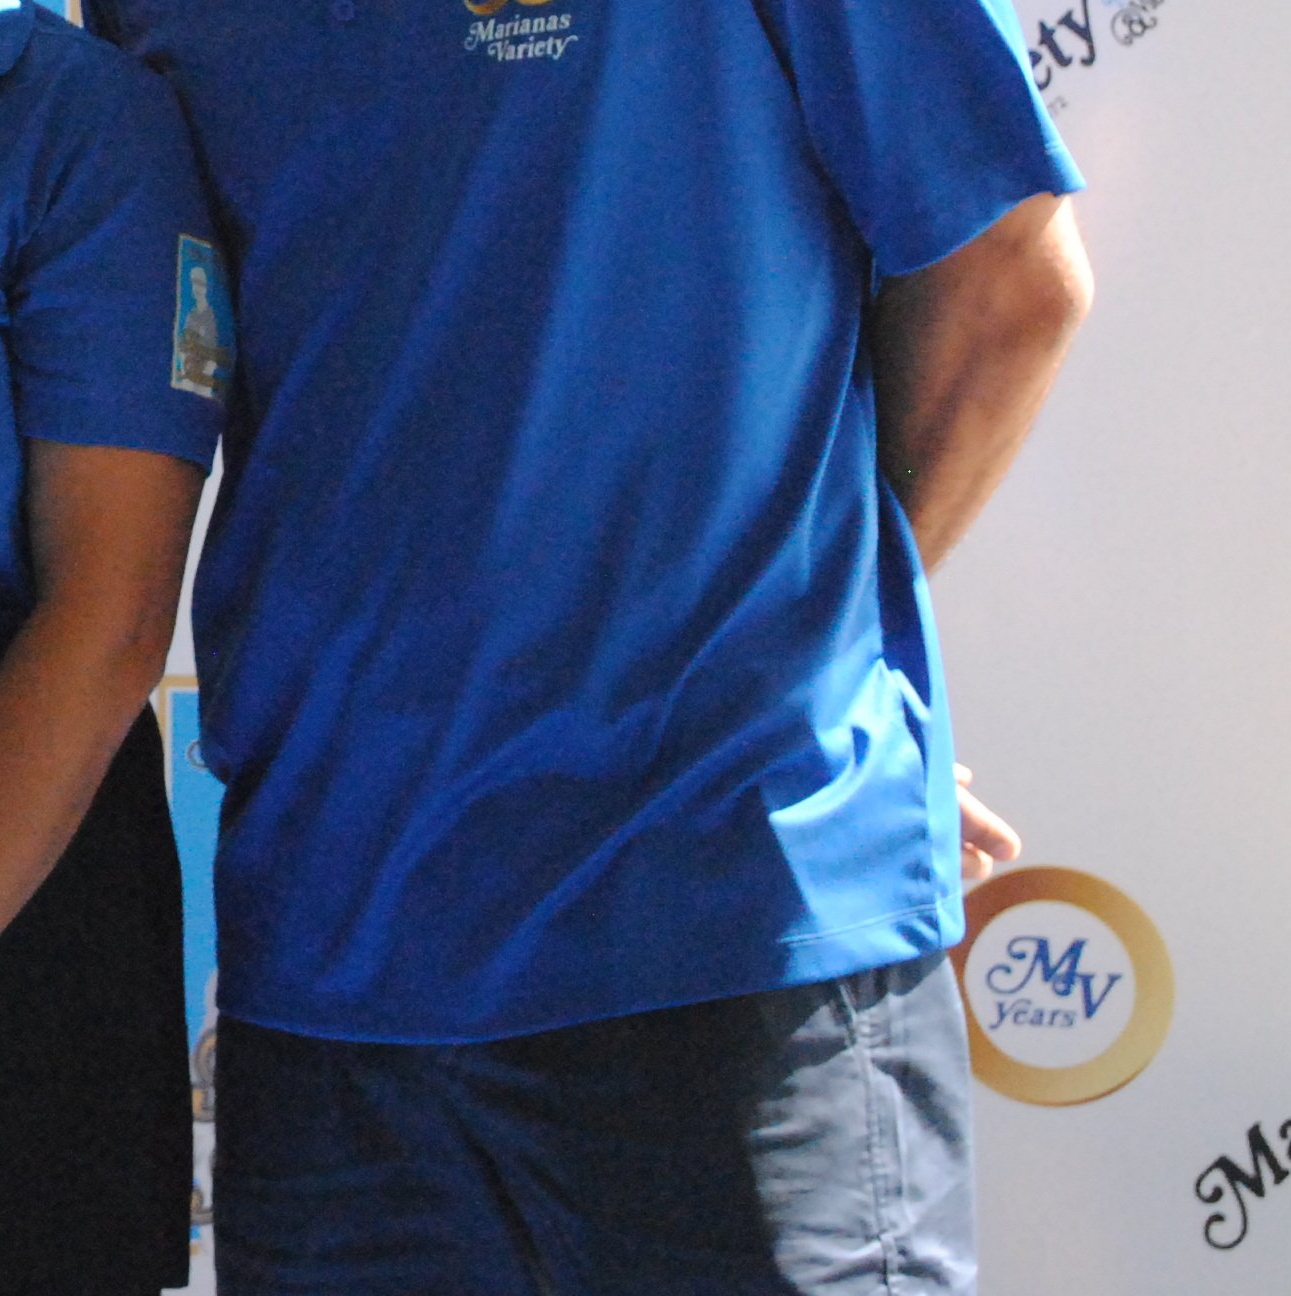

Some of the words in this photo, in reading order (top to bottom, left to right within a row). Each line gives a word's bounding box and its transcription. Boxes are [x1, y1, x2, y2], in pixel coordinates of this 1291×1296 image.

[464, 13, 572, 51] Marianas
[487, 35, 578, 61] Variety
[989, 998, 1077, 1030] years
